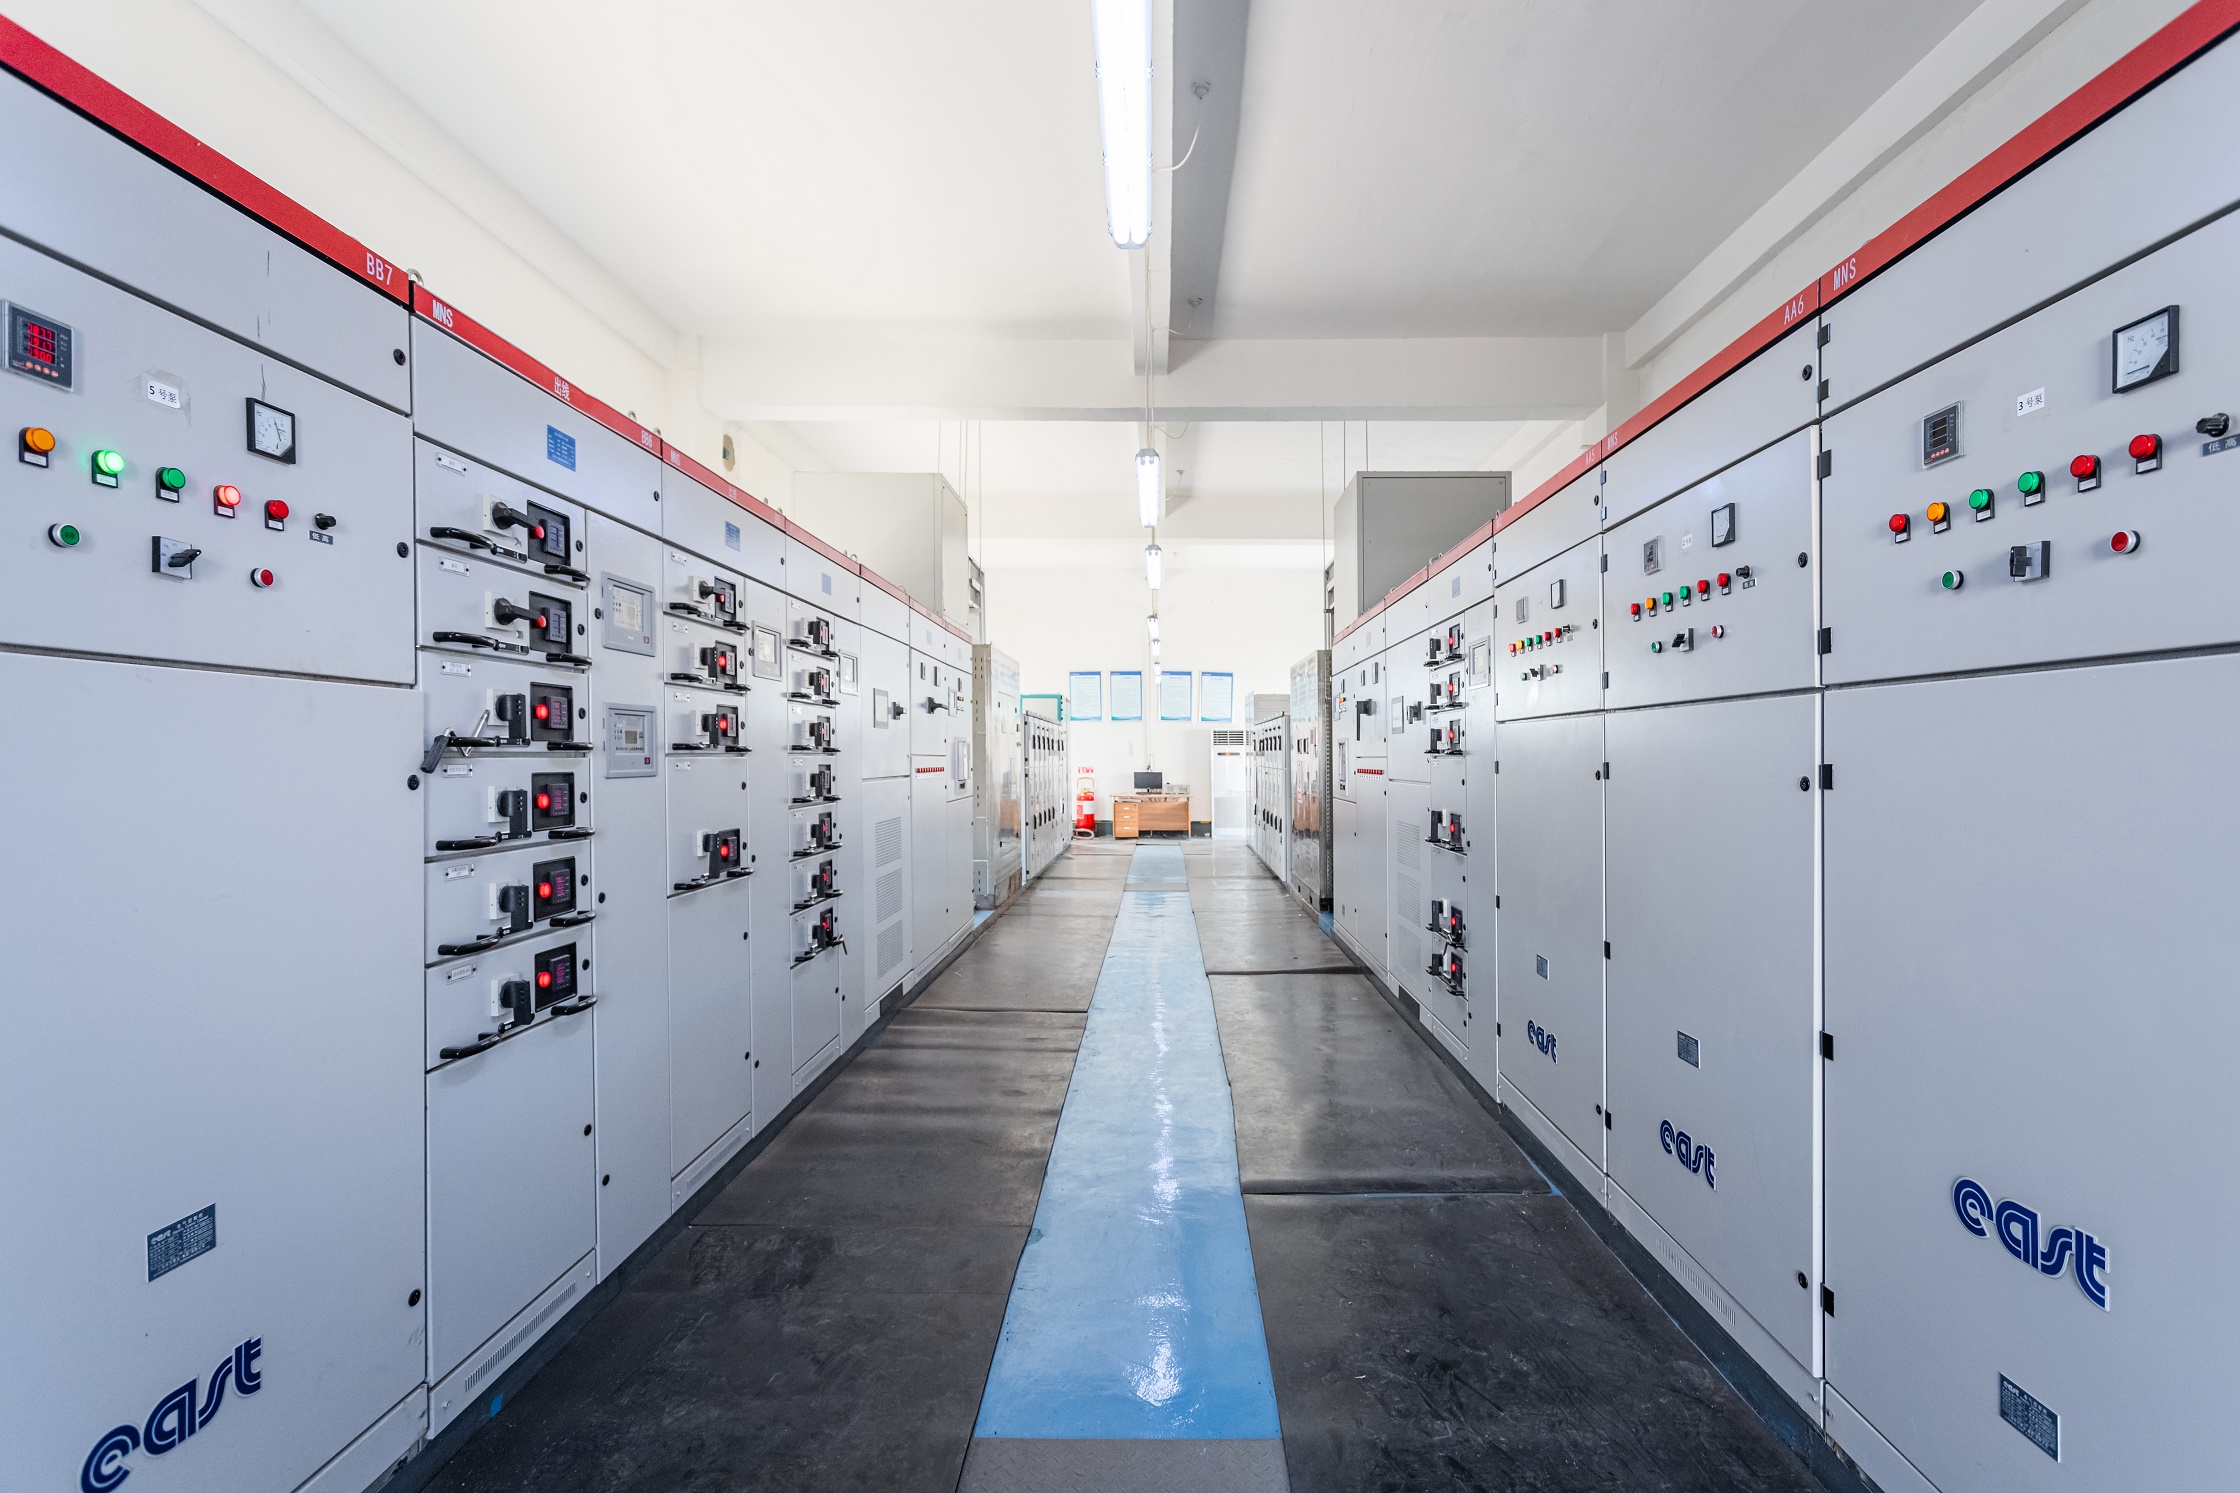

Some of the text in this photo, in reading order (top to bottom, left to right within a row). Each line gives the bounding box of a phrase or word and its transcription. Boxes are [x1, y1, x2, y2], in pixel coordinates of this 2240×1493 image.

[366, 252, 393, 286] BB7
[1833, 257, 1857, 291] MNS
[432, 299, 454, 328] MNS
[1783, 294, 1805, 326] AA6
[149, 385, 155, 395] 5
[2018, 401, 2024, 411] 3
[1527, 1019, 1558, 1064] east
[1660, 1118, 1717, 1192] east
[1953, 1176, 2110, 1313] east
[80, 1335, 263, 1493] east
